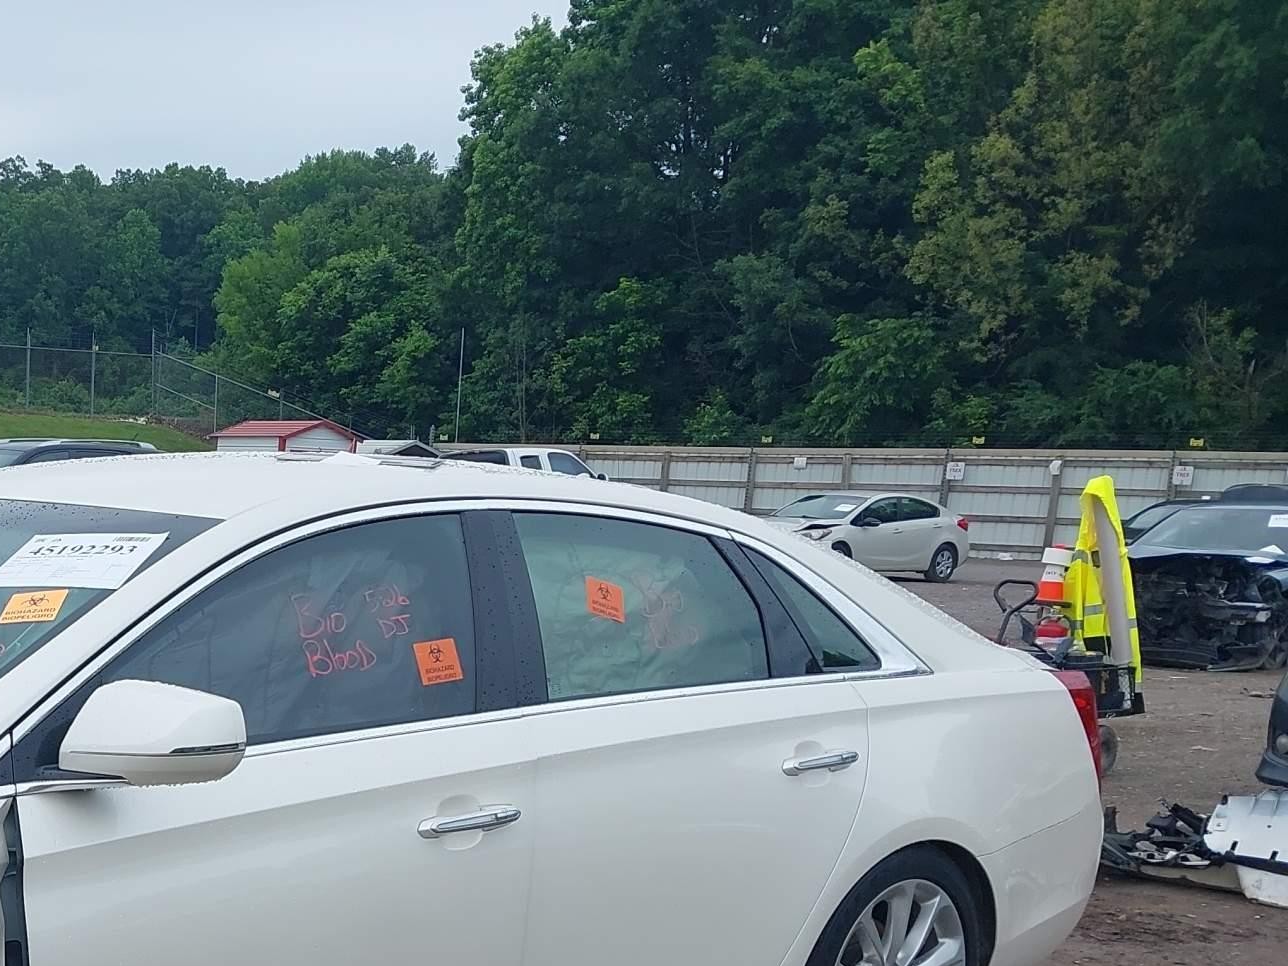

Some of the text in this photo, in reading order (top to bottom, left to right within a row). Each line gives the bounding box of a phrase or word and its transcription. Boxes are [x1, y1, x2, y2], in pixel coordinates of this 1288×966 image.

[28, 544, 138, 556] 45192293
[4, 607, 57, 616] BIOHAZARD
[1, 613, 54, 621] BIOPELIGRO
[376, 614, 411, 639] DJ
